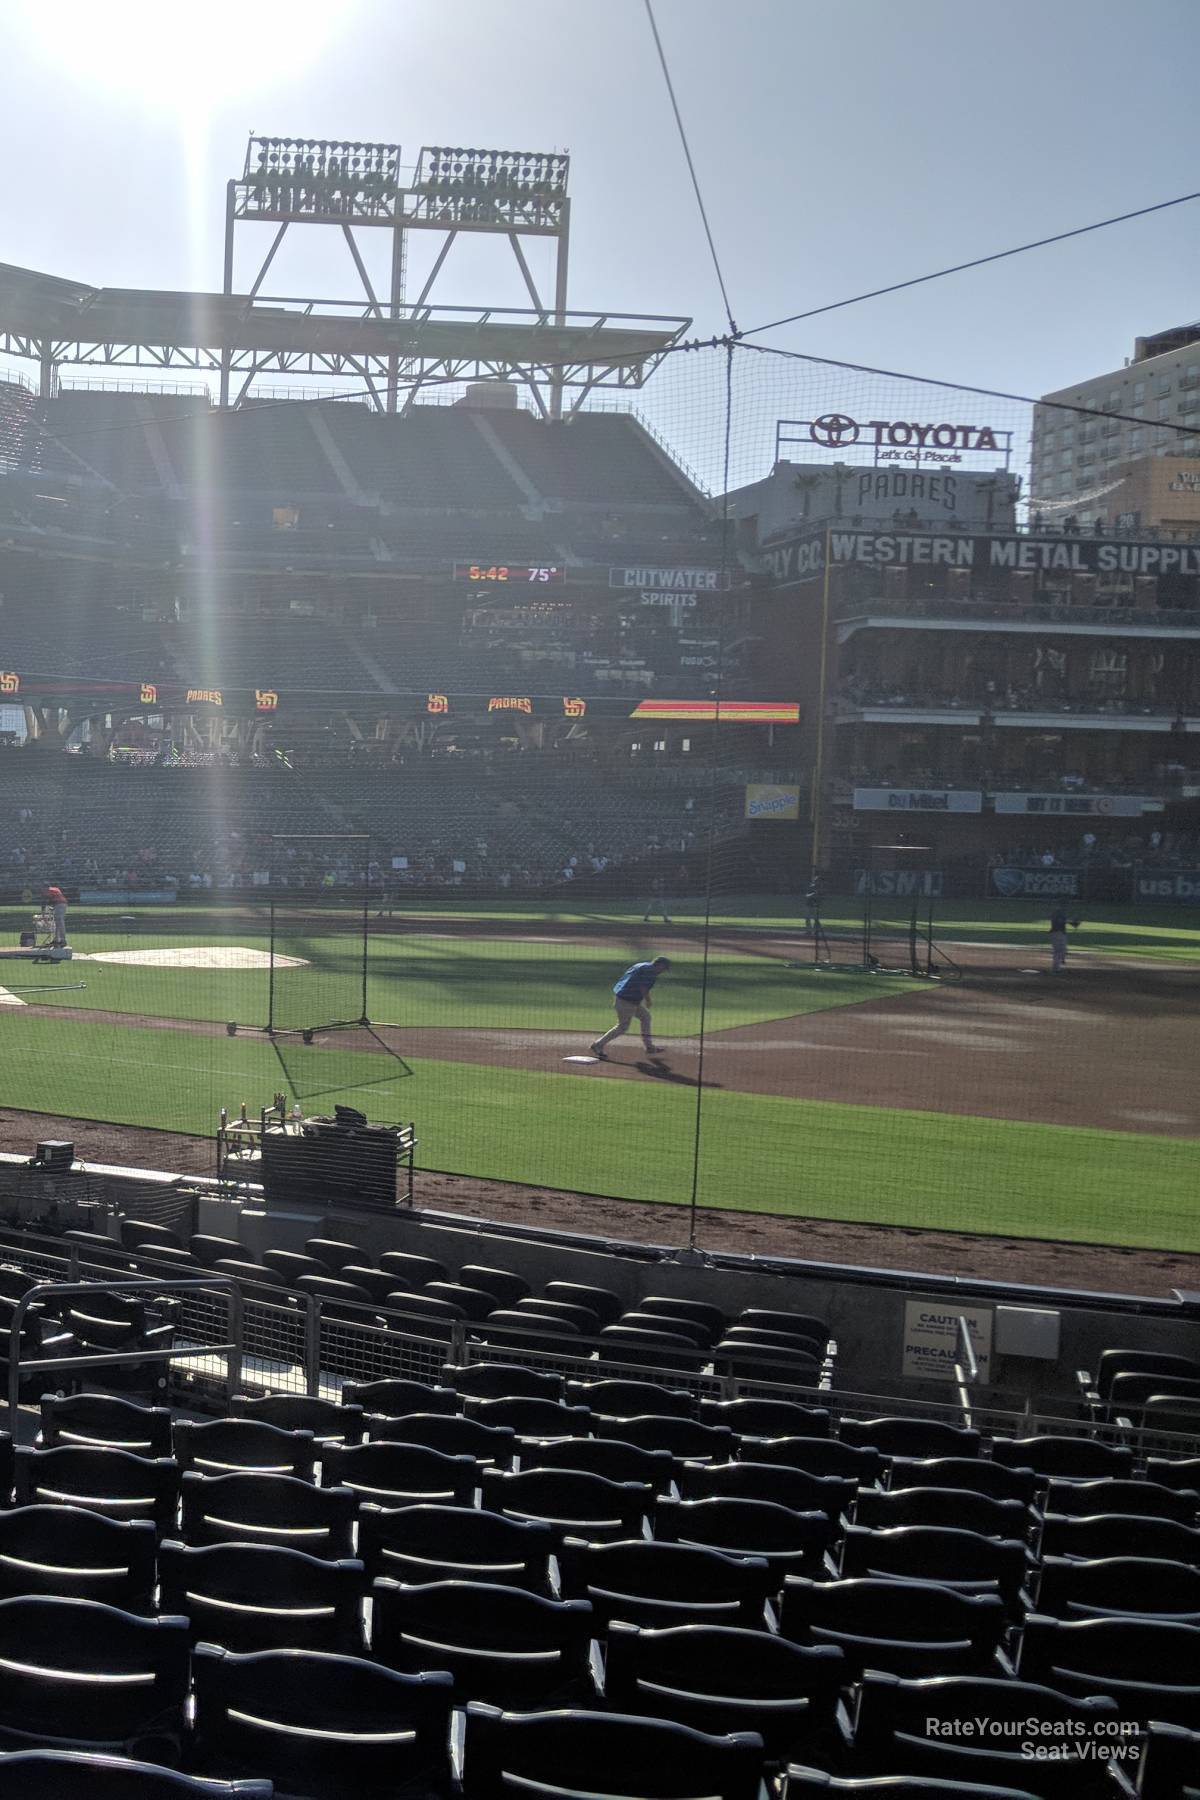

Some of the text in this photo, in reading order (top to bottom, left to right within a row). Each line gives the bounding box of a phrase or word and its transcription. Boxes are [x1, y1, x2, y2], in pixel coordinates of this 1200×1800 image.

[869, 421, 998, 449] TOYOTA
[925, 451, 963, 463] Places
[858, 473, 956, 510] PADRES
[832, 534, 974, 565] WESTERN
[990, 540, 1088, 570] METAL
[469, 566, 508, 580] 5:42
[624, 569, 717, 588] CUTWATER
[641, 592, 697, 606] SPIRITS
[185, 689, 223, 705] PADRES
[488, 697, 532, 713] PADRES
[749, 794, 796, 815] Snapple
[919, 1313, 977, 1328] CAUTIN
[905, 1344, 988, 1362] PRECAUN
